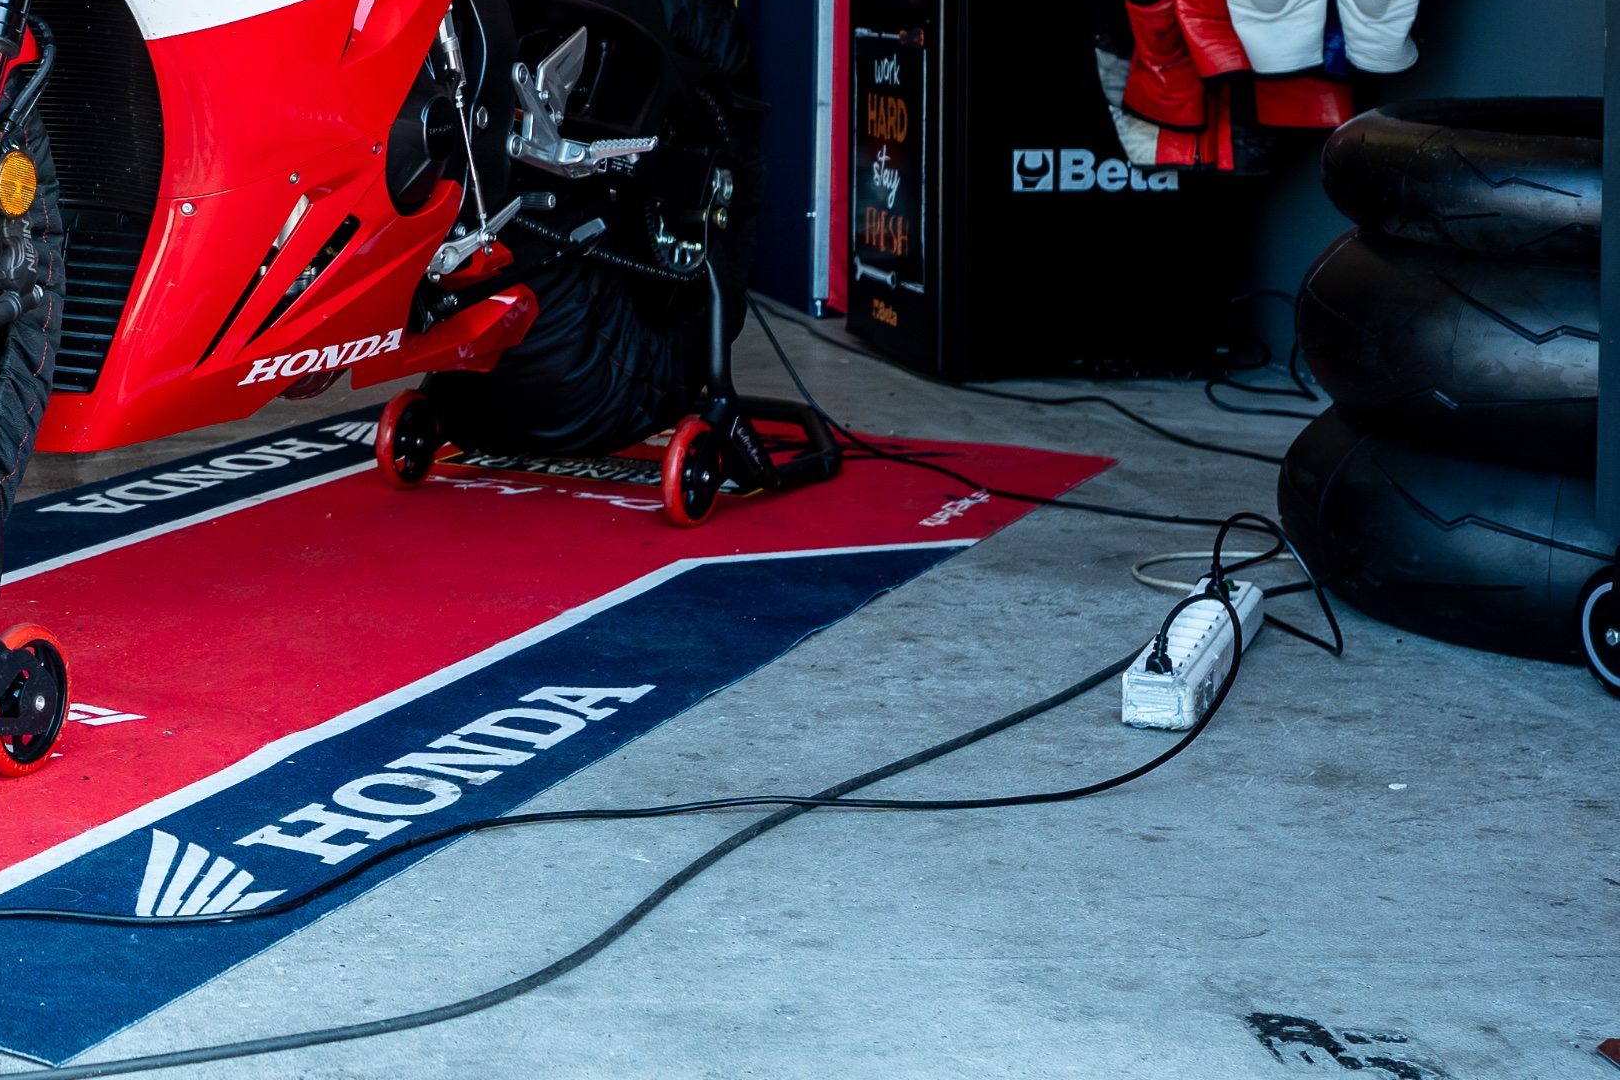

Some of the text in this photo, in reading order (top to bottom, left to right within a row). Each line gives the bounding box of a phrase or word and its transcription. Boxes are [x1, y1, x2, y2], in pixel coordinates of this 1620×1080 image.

[874, 53, 901, 86] work
[867, 92, 908, 143] HARD
[872, 144, 901, 209] stay
[1060, 148, 1179, 191] Beta
[21, 218, 37, 273] NISSIN
[865, 206, 909, 257] FRESH
[237, 328, 404, 387] HONDA
[36, 438, 347, 515] HONDA
[236, 683, 658, 866] HONDA
